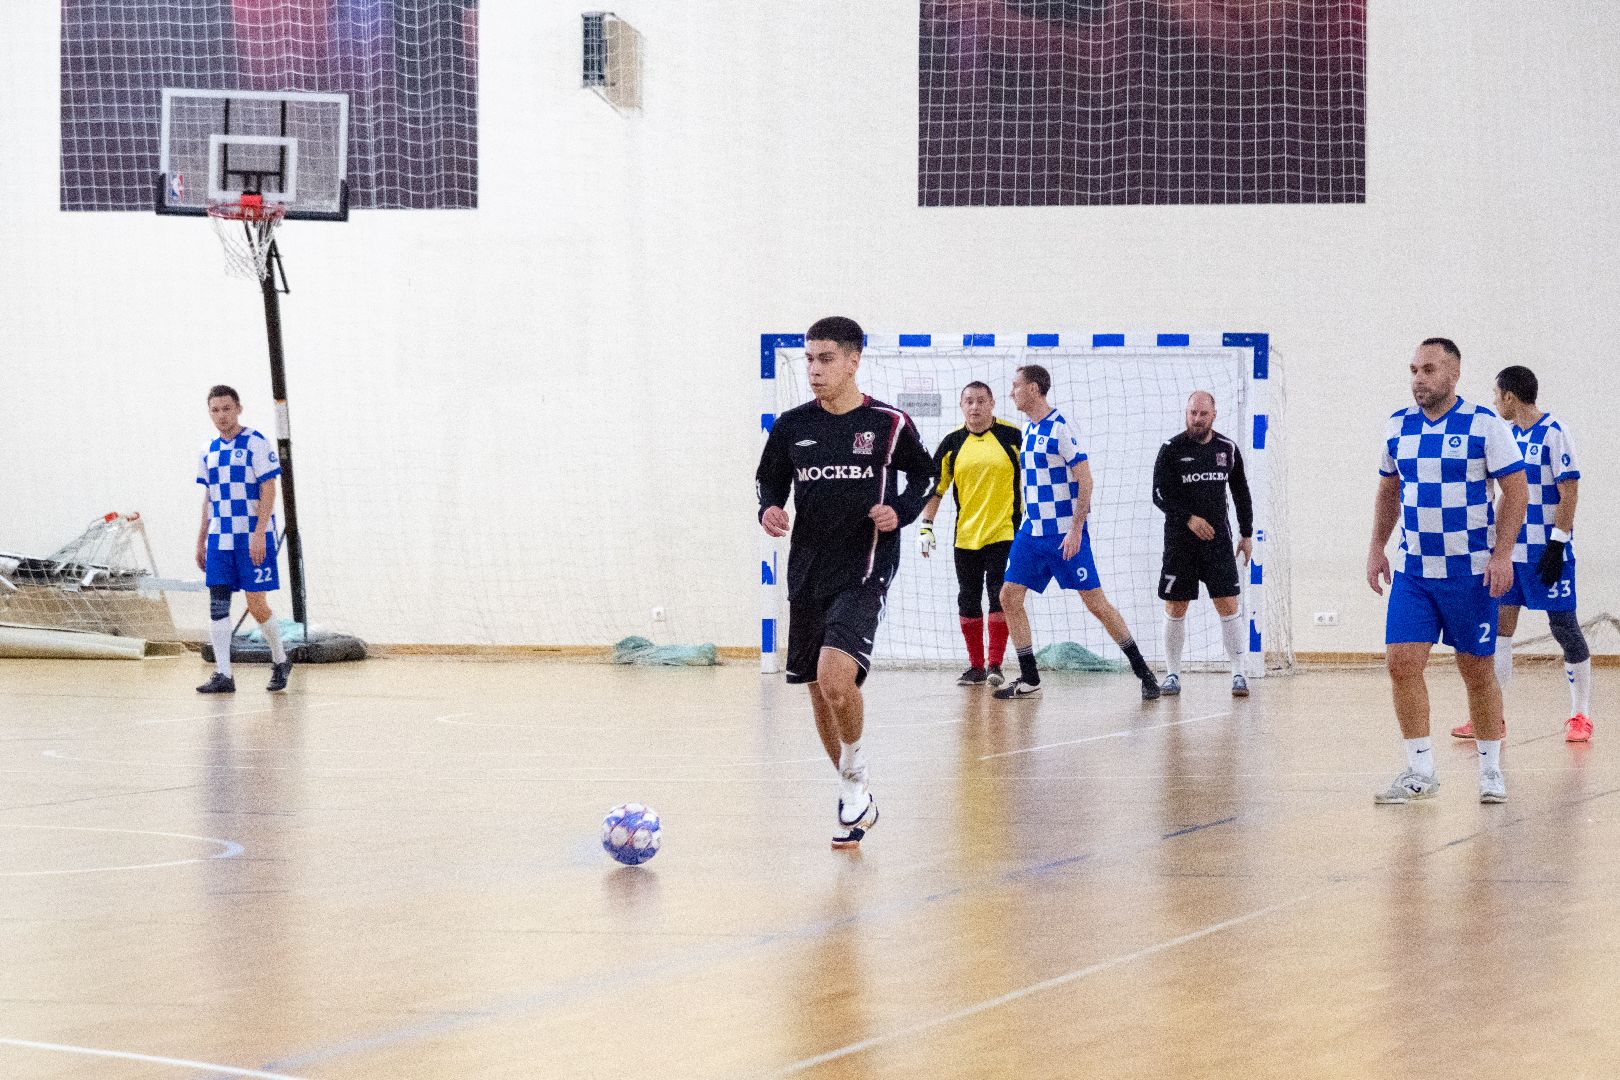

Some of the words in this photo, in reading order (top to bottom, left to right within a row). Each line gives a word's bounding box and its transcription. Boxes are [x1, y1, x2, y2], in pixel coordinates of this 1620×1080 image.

[796, 465, 874, 482] МОСКВА
[1181, 472, 1229, 484] МОСКВА
[254, 567, 272, 584] 22
[1076, 567, 1088, 582] 9
[1164, 574, 1177, 594] 7
[1547, 579, 1571, 599] 33
[1478, 622, 1491, 644] 2
